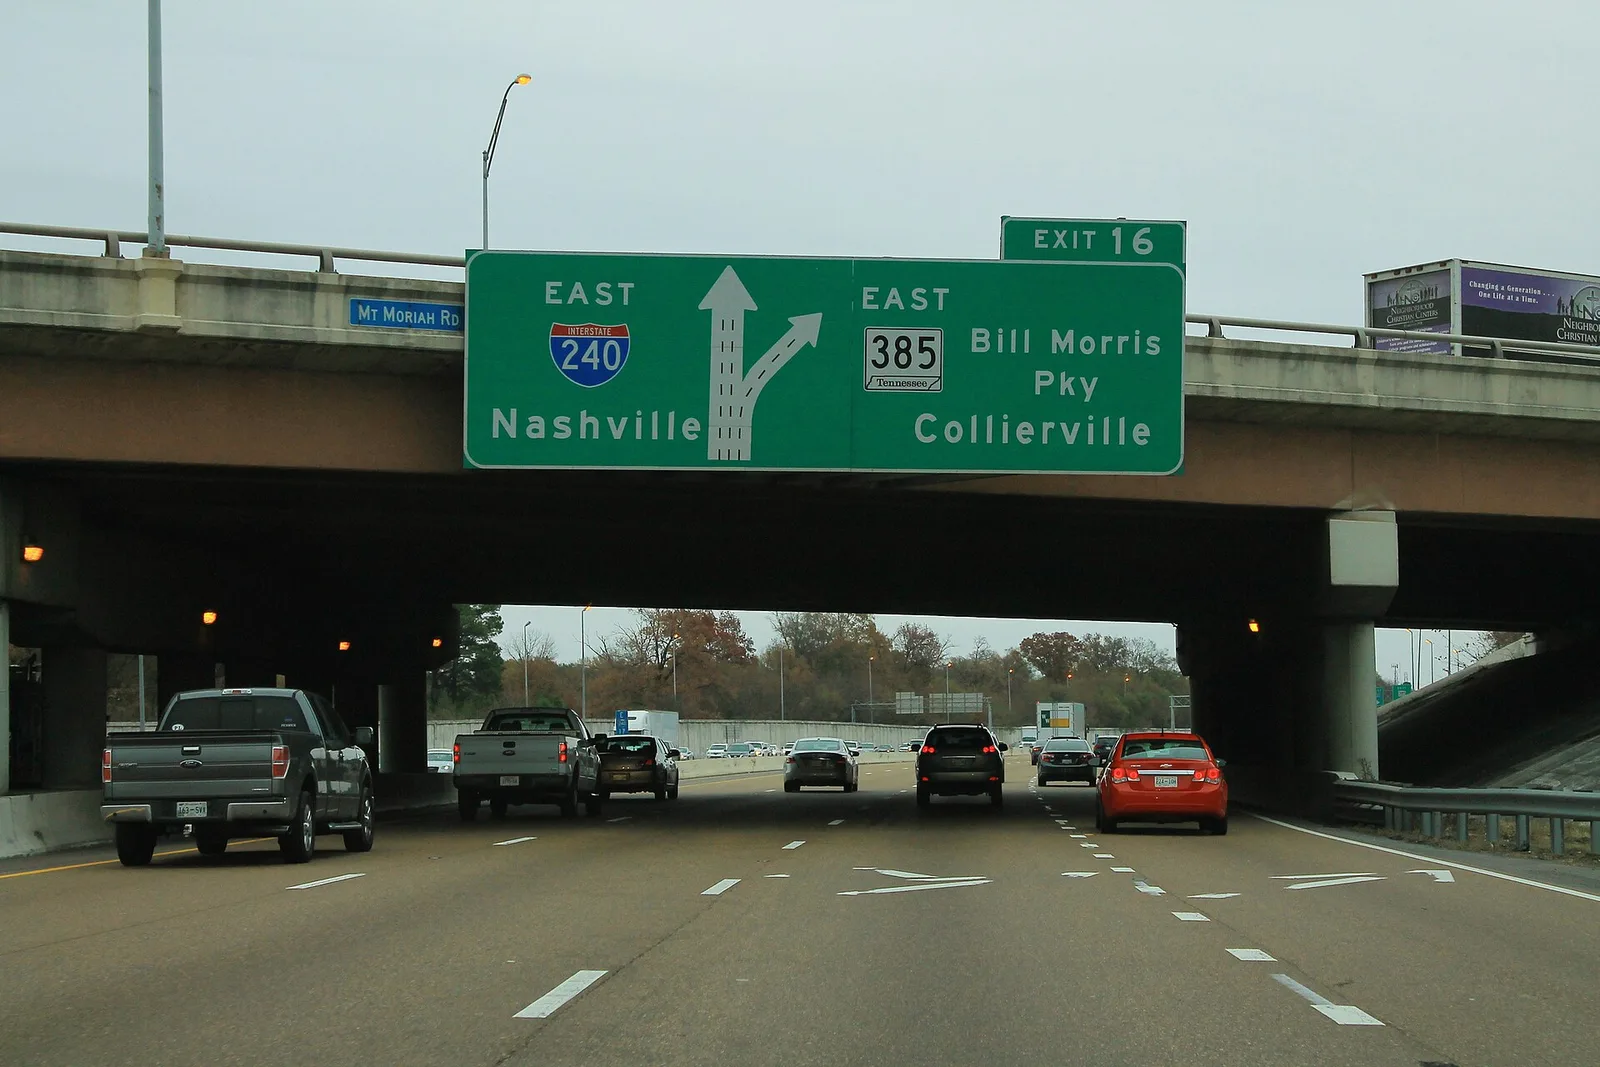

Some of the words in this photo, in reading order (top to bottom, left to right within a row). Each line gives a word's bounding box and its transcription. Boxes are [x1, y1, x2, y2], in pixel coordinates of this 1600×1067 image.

[1034, 229, 1096, 249] EXIT
[1112, 227, 1154, 255] 16
[545, 281, 635, 306] EAST
[862, 287, 949, 311] EAST
[1469, 280, 1499, 291] Changing
[1506, 285, 1541, 295] Generation
[1478, 291, 1491, 299] One
[1492, 292, 1505, 300] Life
[1521, 295, 1539, 304] Time.
[358, 304, 378, 321] MT
[383, 306, 435, 325] MORIAH
[441, 309, 460, 326] RD
[1563, 317, 1600, 333] NEIGHBO
[567, 325, 612, 336] INTERSTATE
[971, 328, 1030, 354] Bill
[1051, 329, 1161, 356] Morris
[1556, 327, 1598, 343] CHRISTIAN
[561, 339, 621, 371] 240
[871, 335, 936, 370] 385
[876, 378, 928, 388] Tennessee
[1034, 370, 1099, 402] Pky
[491, 408, 701, 441] Nashville
[914, 412, 1151, 446] Collierville
